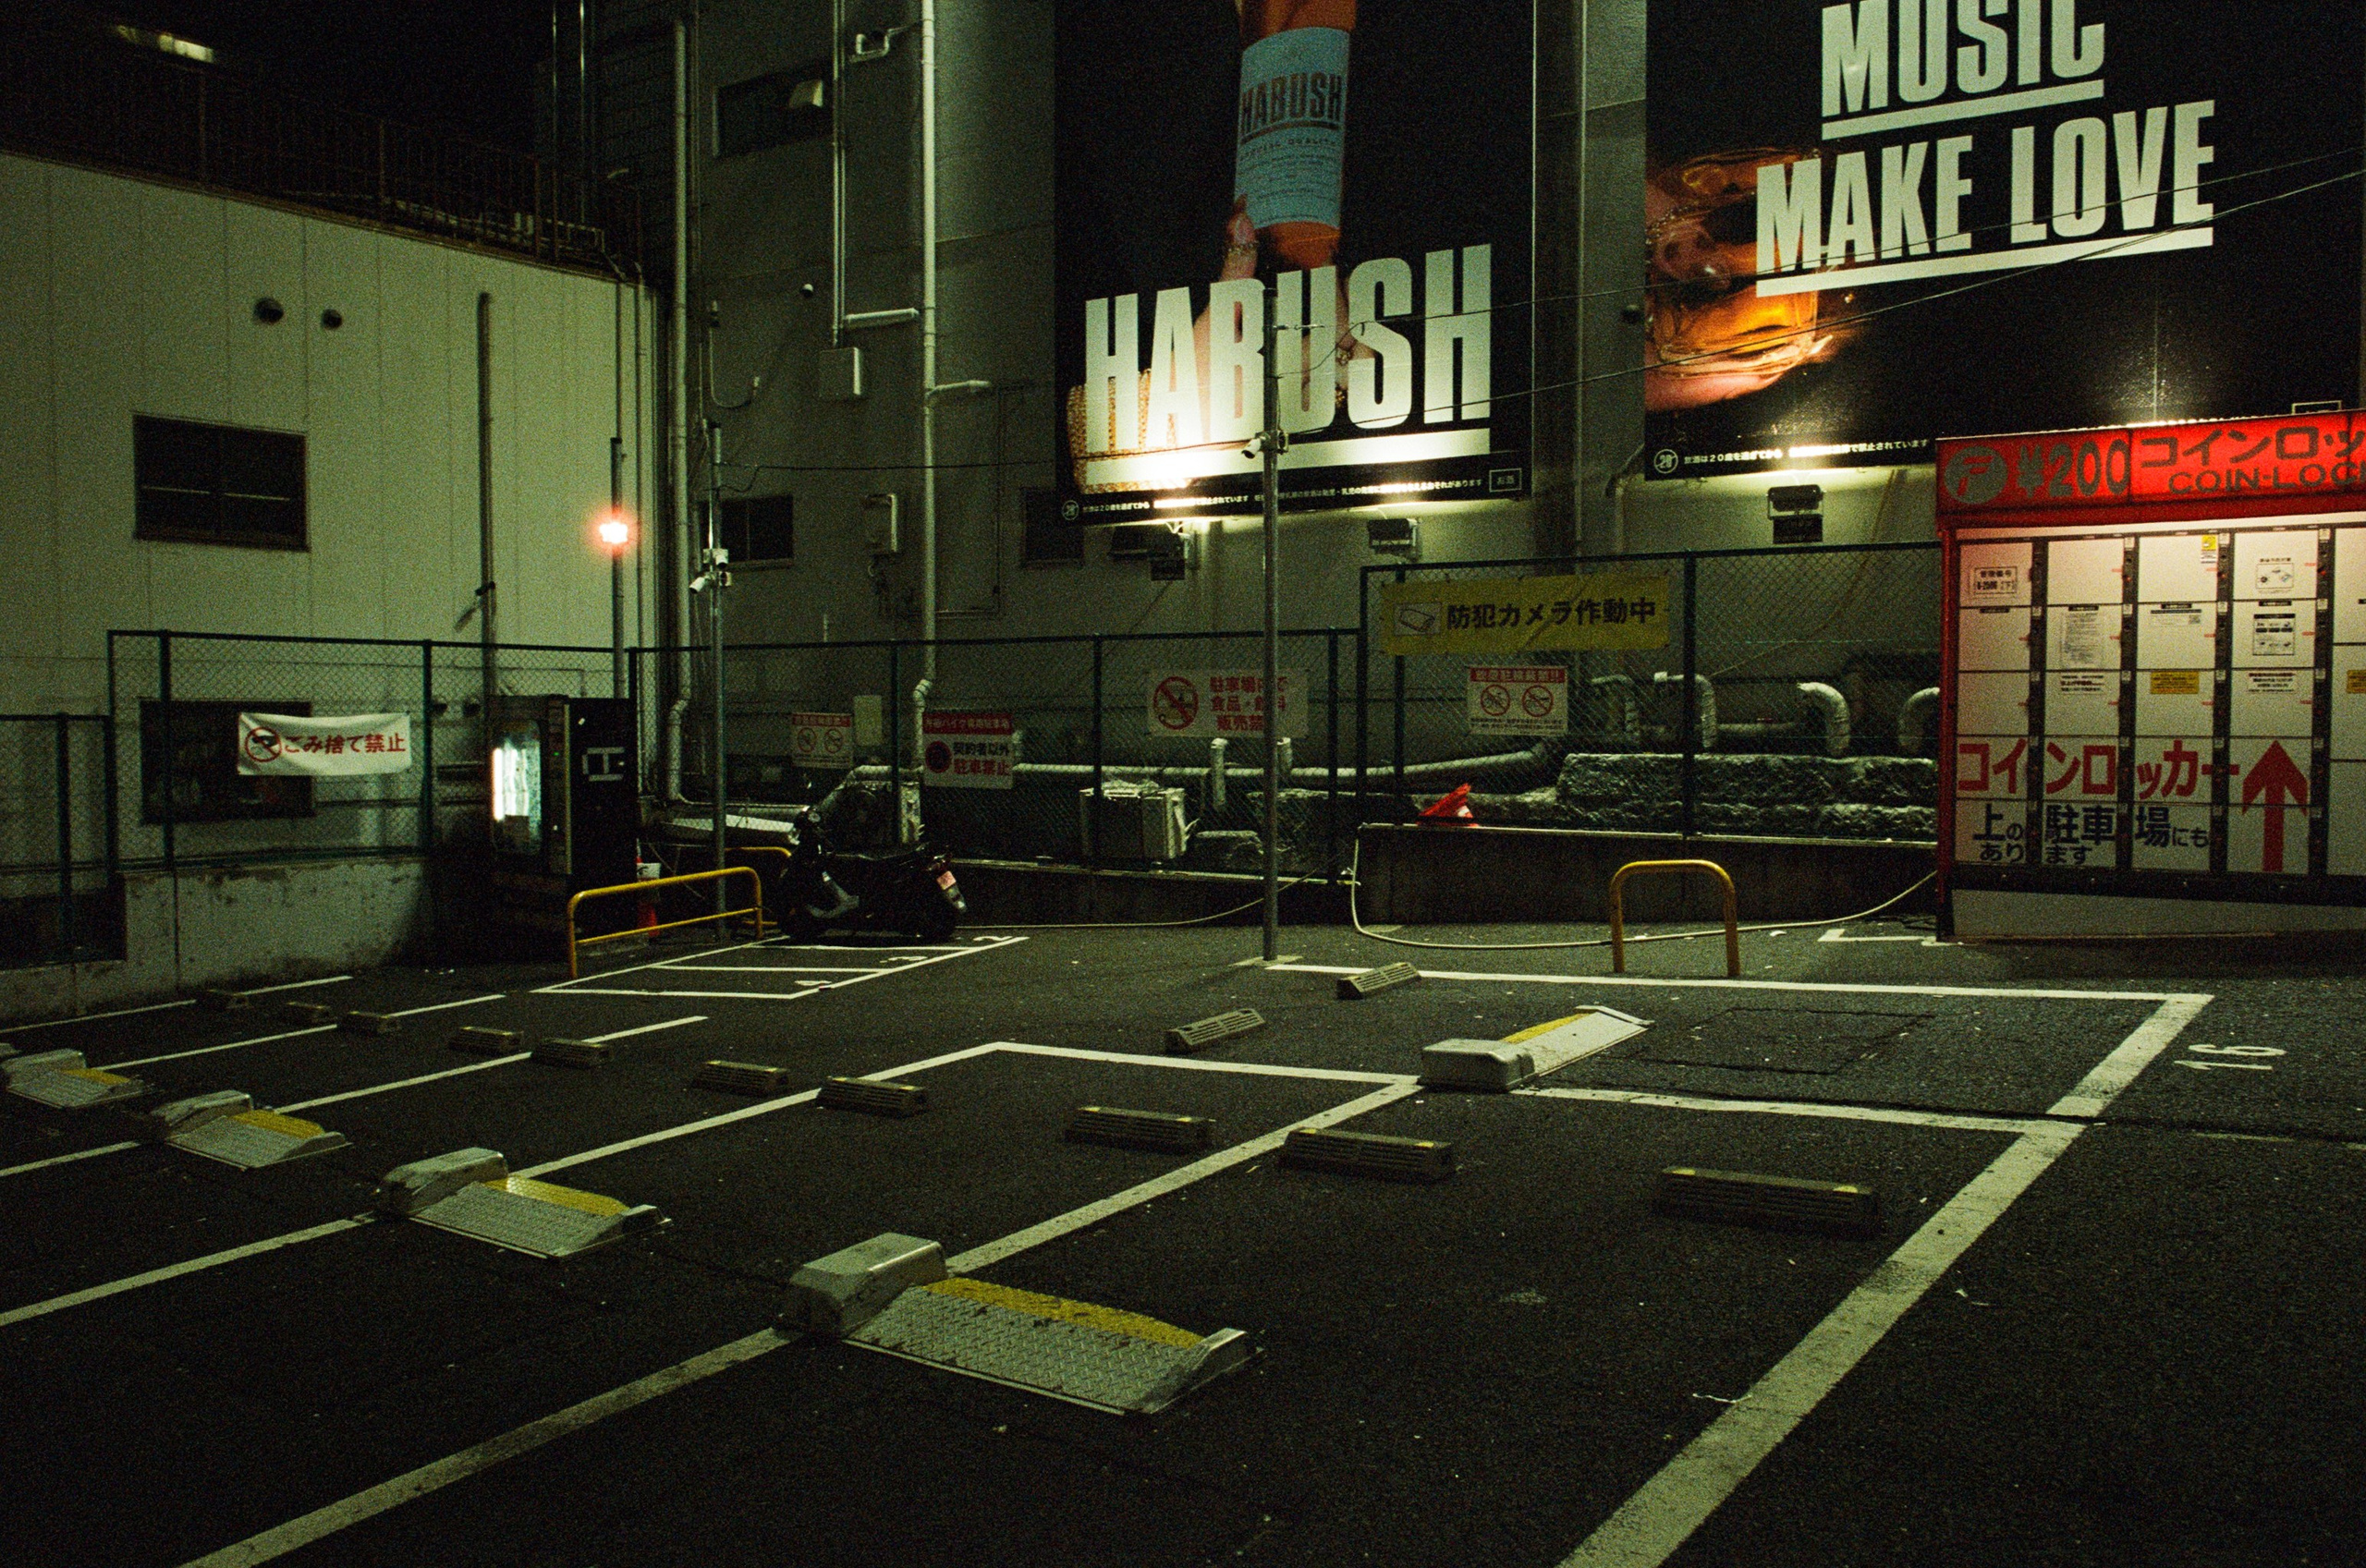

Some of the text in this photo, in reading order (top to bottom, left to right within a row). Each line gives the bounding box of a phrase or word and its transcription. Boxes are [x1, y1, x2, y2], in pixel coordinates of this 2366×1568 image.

[1822, 0, 2105, 117] MUSIC
[1239, 71, 1341, 138] HABUSH
[1757, 99, 2215, 273] MAKE LOVE
[1086, 244, 1491, 452] HABUSH
[2016, 439, 2131, 499] ¥200
[1446, 597, 1656, 630] 防犯カメラ作動中
[285, 733, 406, 754] ごみ捨て禁止
[1216, 714, 1264, 731] 販売禁
[1957, 739, 2240, 801] コインロッカー
[1972, 803, 2209, 849] 上の駐車場にも
[1980, 843, 2092, 865] あります
[2174, 1043, 2288, 1071] 16
